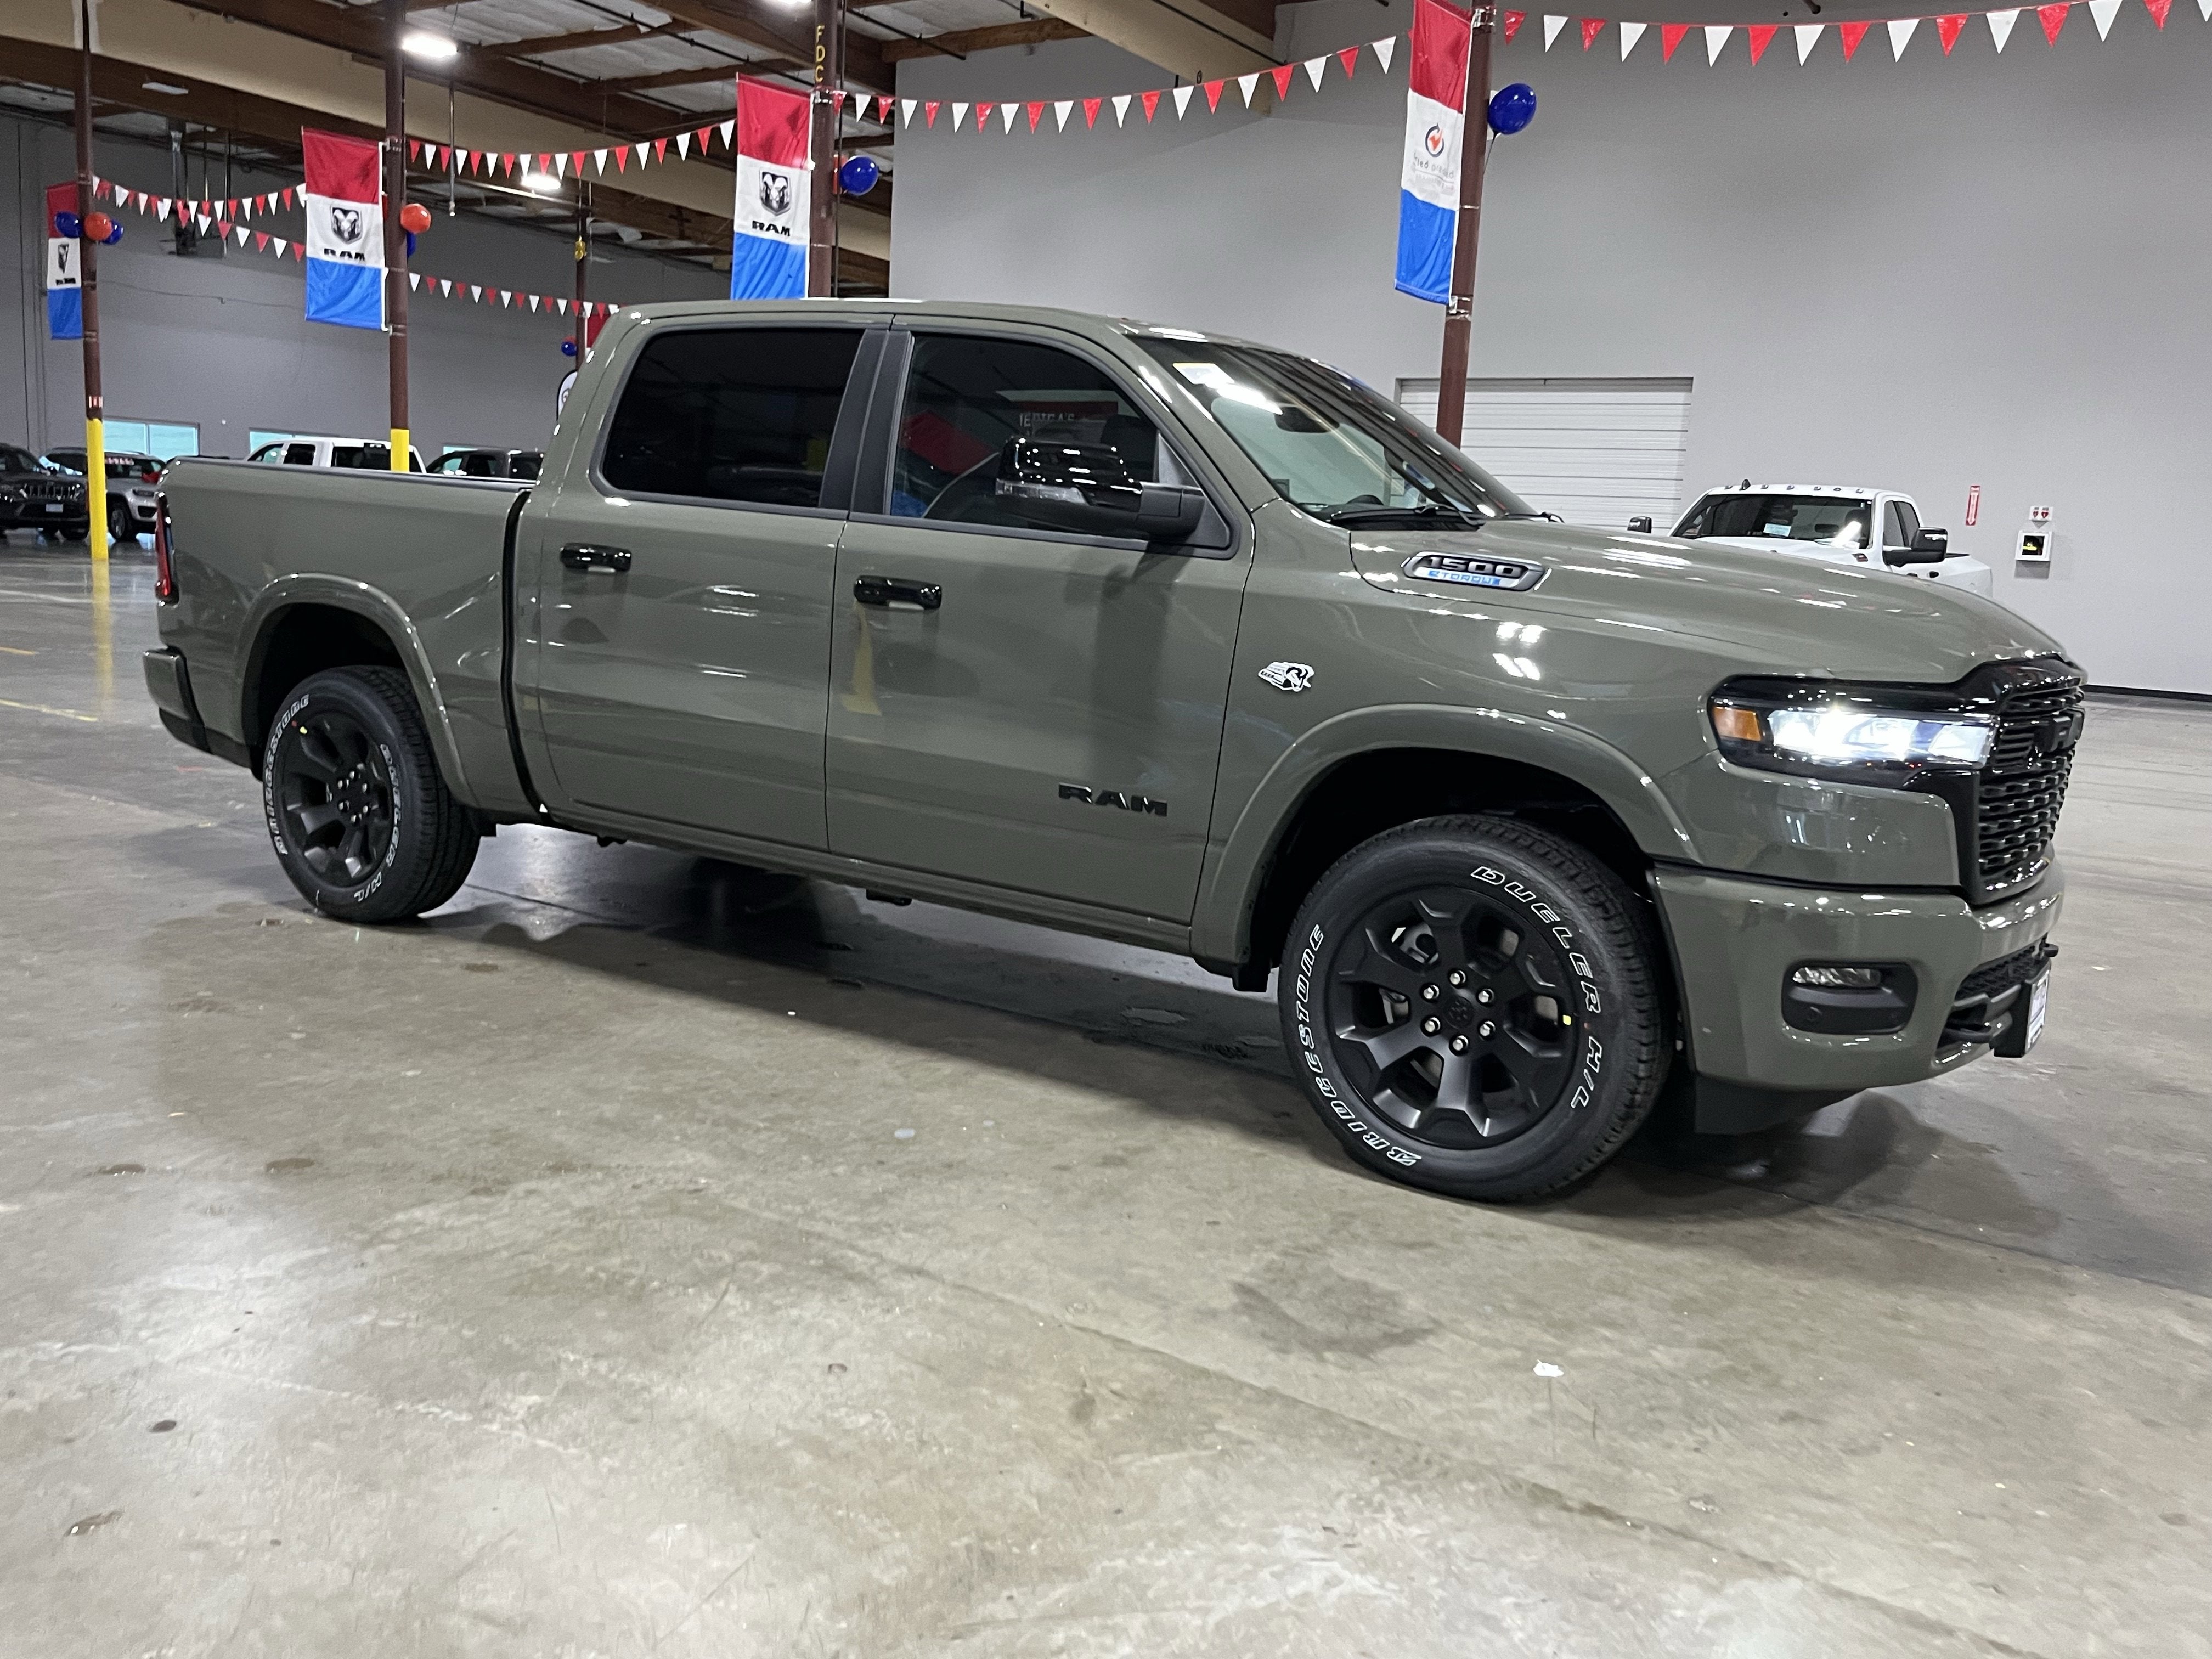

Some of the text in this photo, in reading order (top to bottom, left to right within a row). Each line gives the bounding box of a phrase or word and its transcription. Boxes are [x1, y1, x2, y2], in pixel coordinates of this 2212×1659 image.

[815, 25, 826, 82] FDC
[752, 220, 791, 236] RAM
[1428, 556, 1522, 577] 1500
[1059, 782, 1167, 817] RAM
[1470, 866, 1602, 1109] DUELER H/L
[1296, 924, 1421, 1166] BRIDGESTONE
